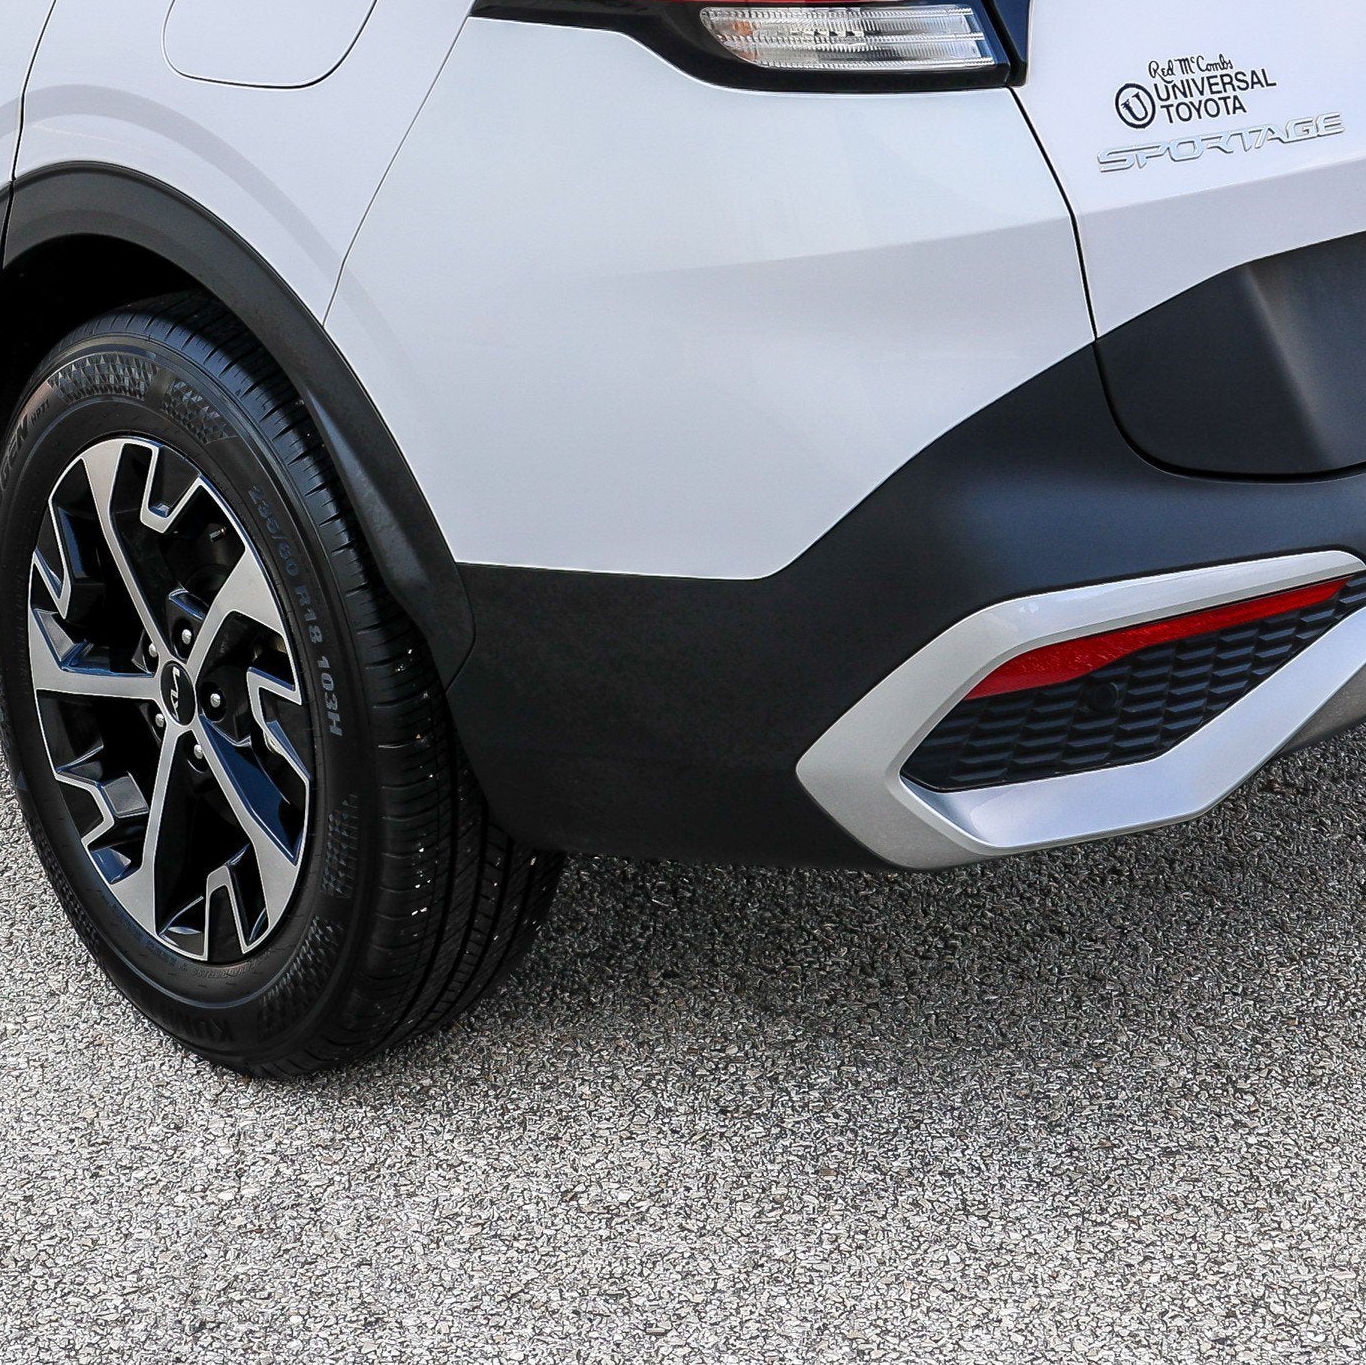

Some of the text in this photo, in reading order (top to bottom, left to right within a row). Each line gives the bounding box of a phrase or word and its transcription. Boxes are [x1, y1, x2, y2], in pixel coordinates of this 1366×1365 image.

[1148, 59, 1175, 84] Red
[1153, 68, 1278, 102] UNIVERSAL
[1160, 95, 1248, 124] TOYOTA
[1097, 112, 1346, 173] SPORTAGE
[294, 585, 325, 644] R18
[318, 655, 344, 738] 103H
